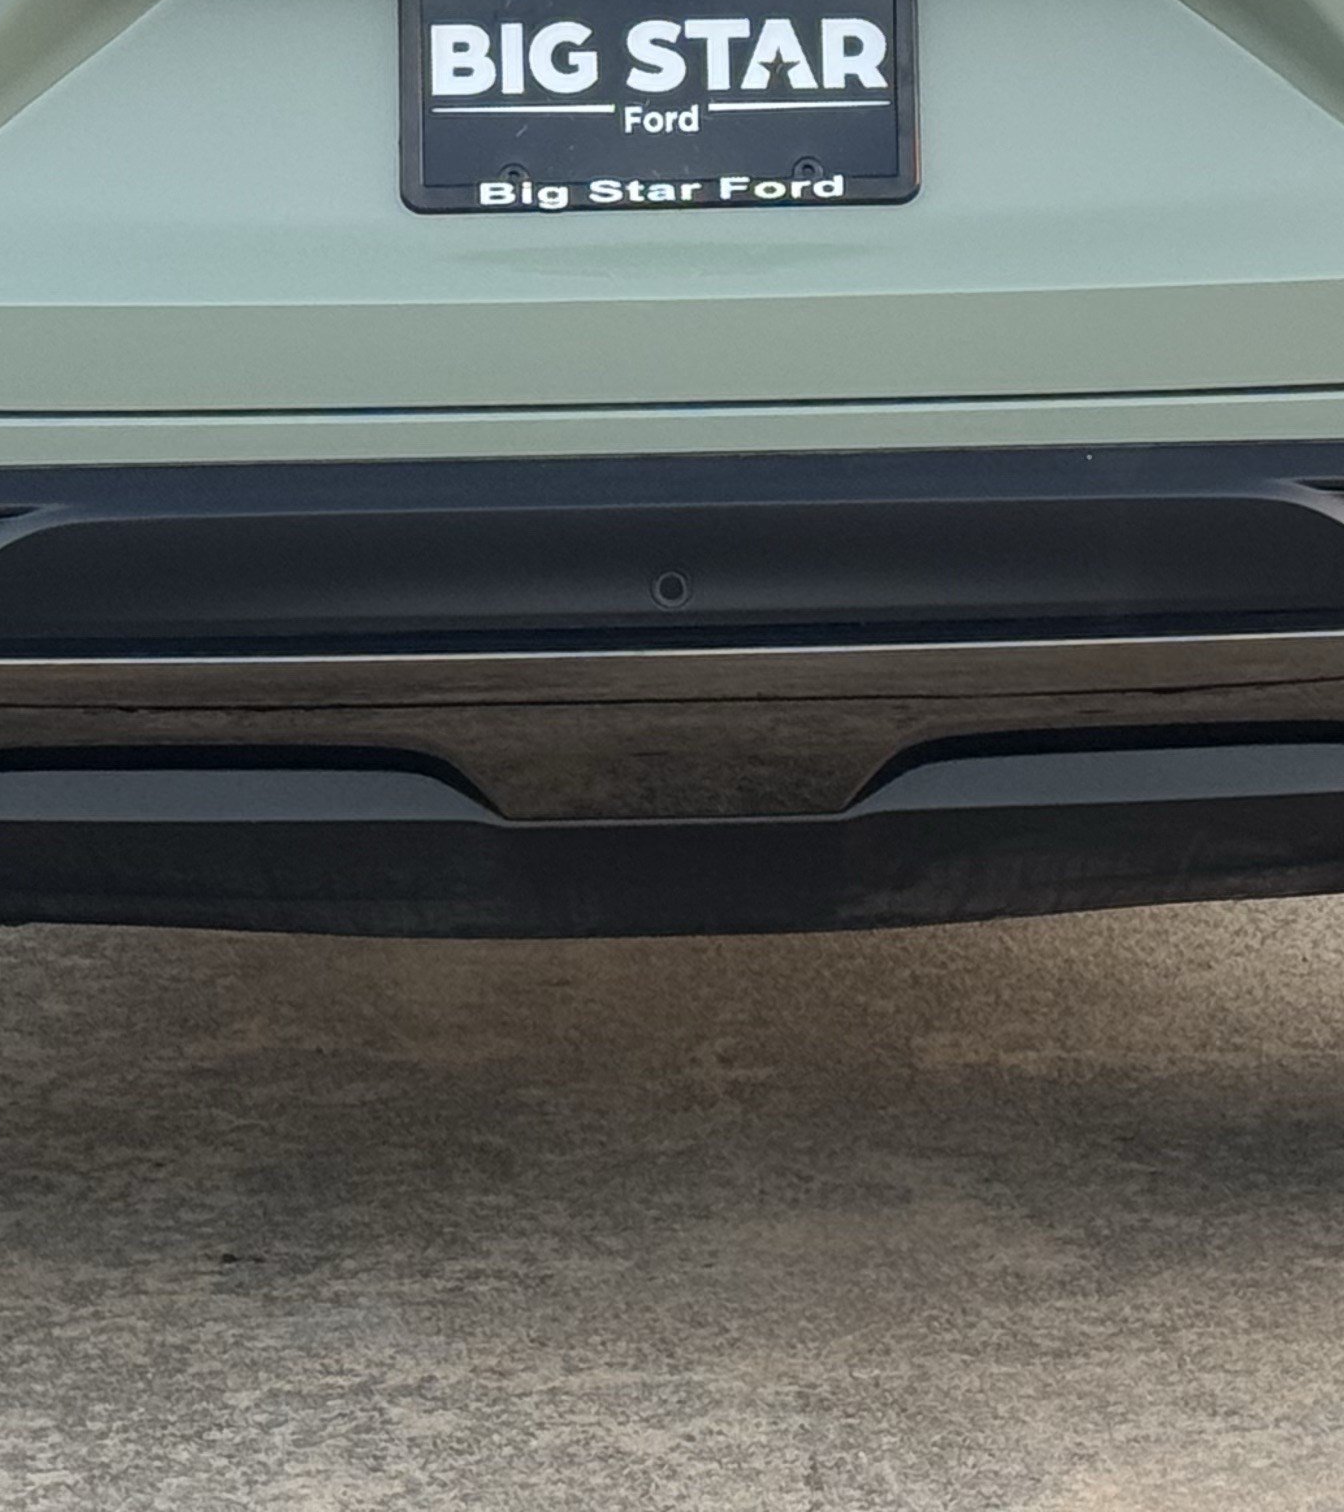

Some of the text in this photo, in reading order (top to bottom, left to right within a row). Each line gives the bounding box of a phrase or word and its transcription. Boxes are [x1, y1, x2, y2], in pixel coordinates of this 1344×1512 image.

[430, 18, 888, 96] BIG STAR
[624, 104, 700, 134] Ford
[479, 175, 846, 210] Big Star Ford
